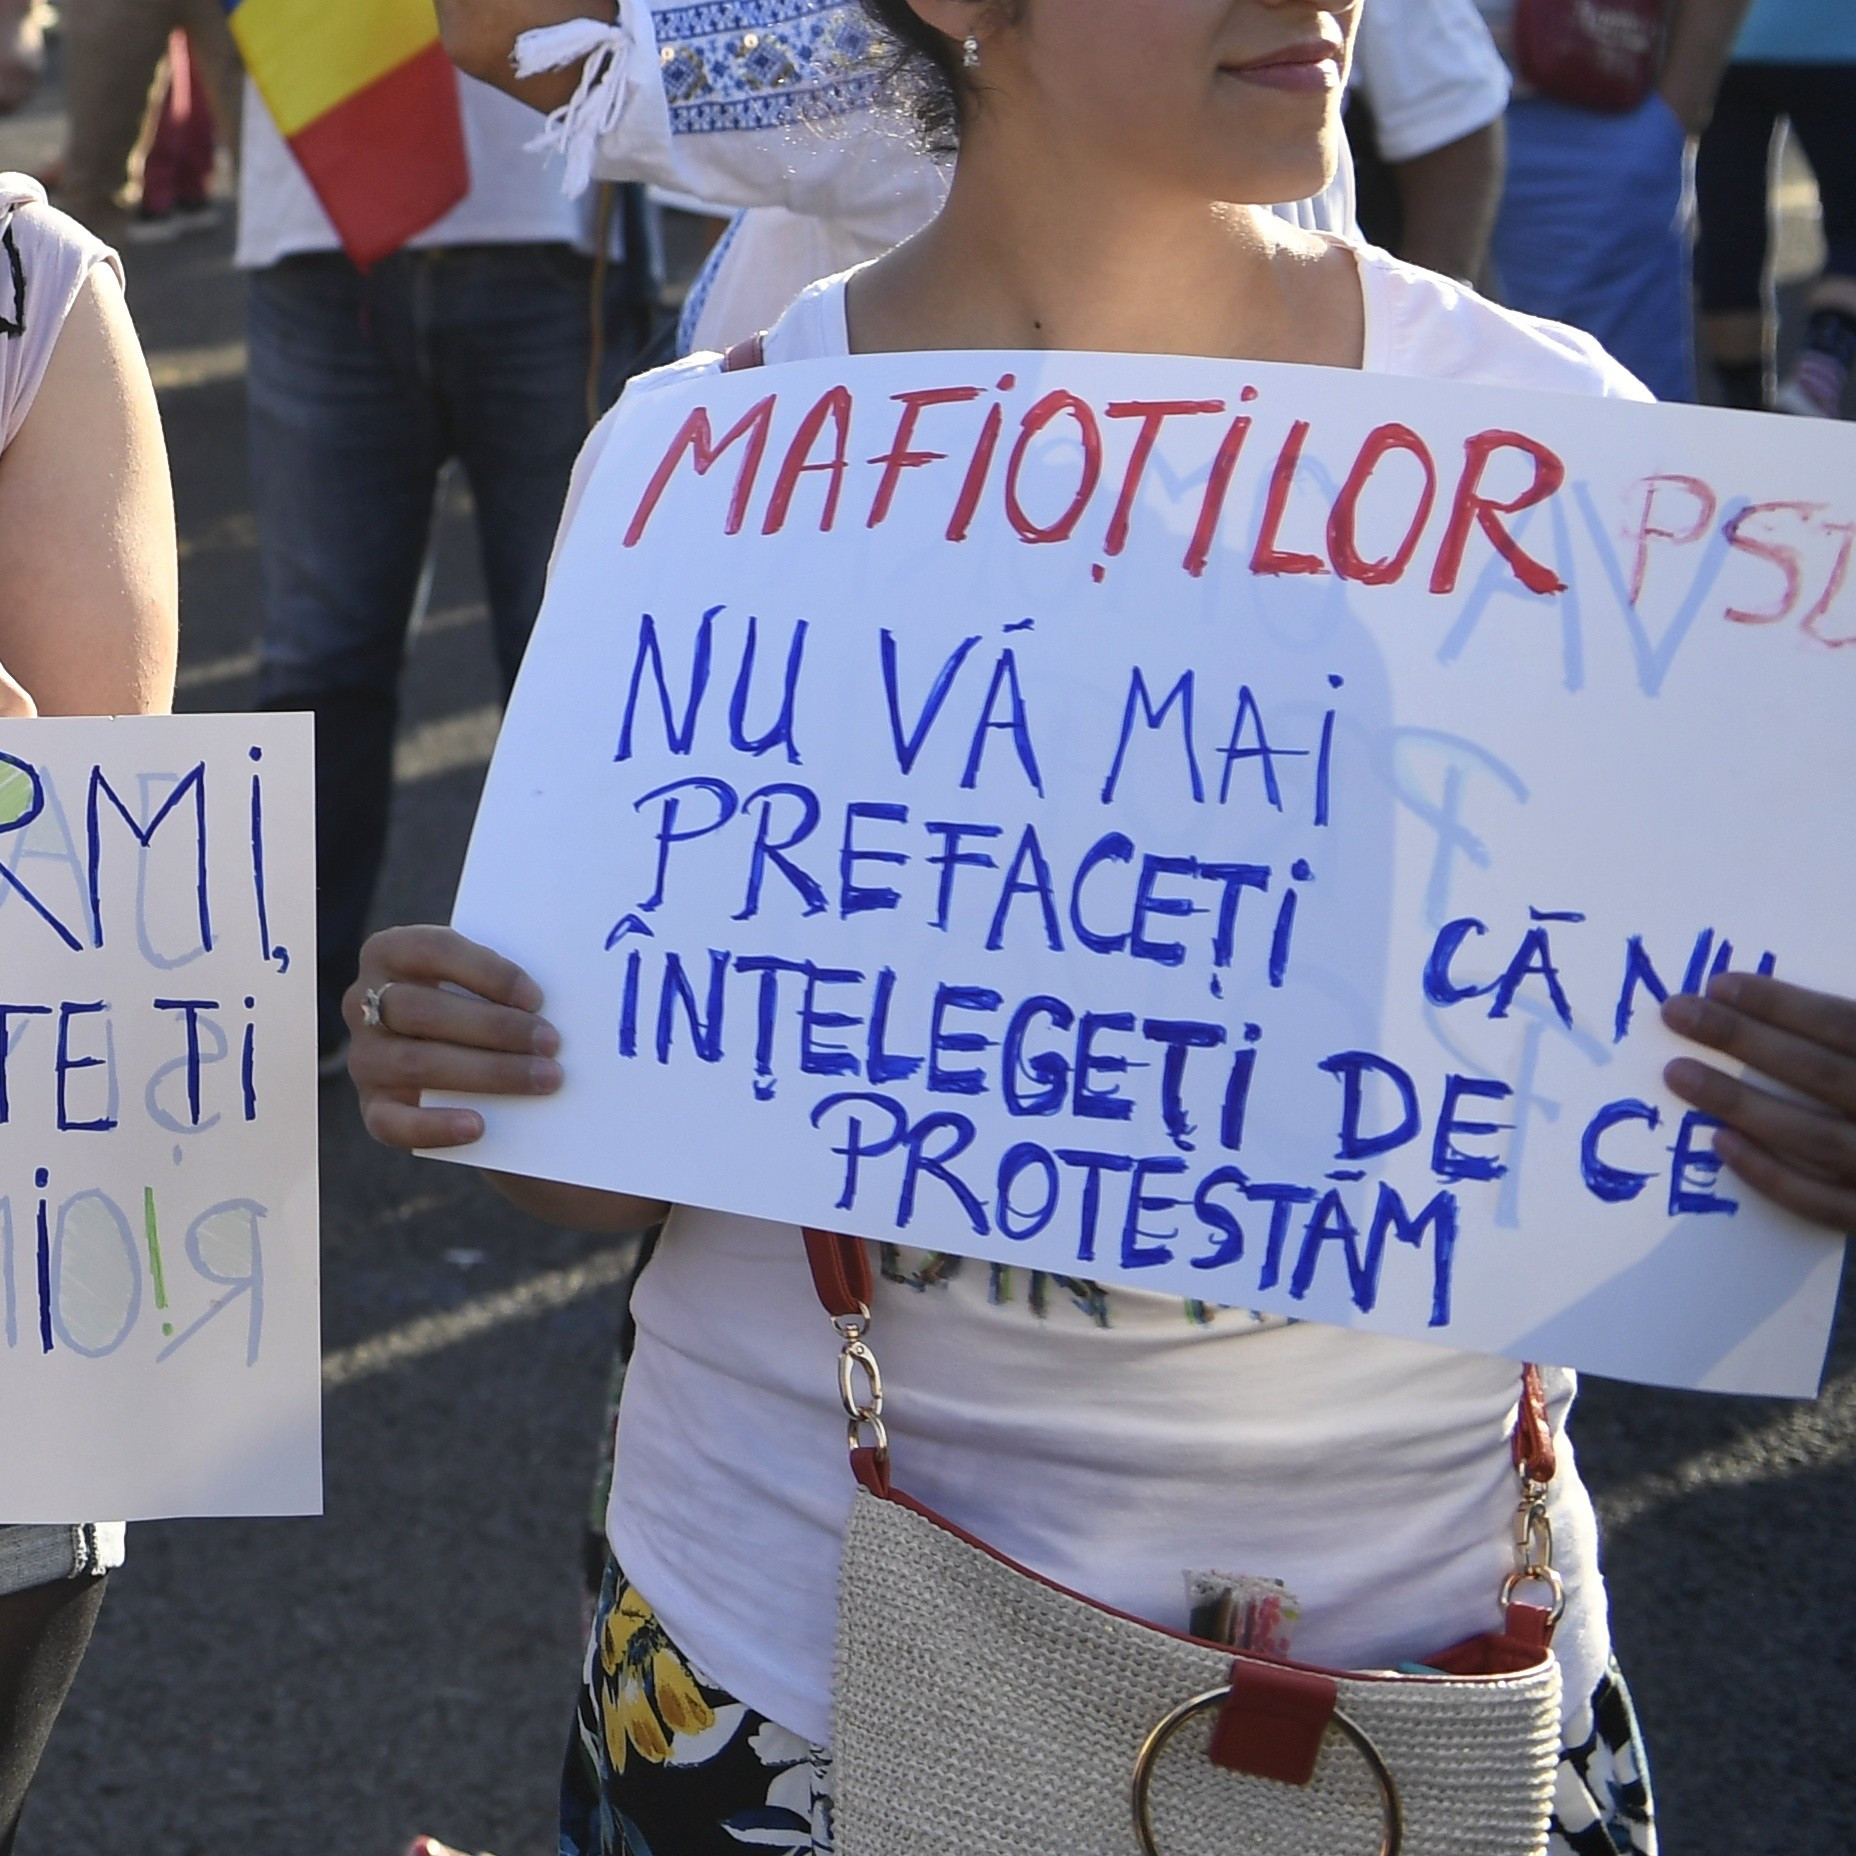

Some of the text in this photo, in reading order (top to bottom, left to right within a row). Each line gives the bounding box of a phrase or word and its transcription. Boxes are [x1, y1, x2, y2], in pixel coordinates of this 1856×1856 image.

[613, 604, 1344, 826] NU VĂ MAI
[1319, 1051, 1516, 1183] DE
[1581, 1097, 1739, 1217] CE
